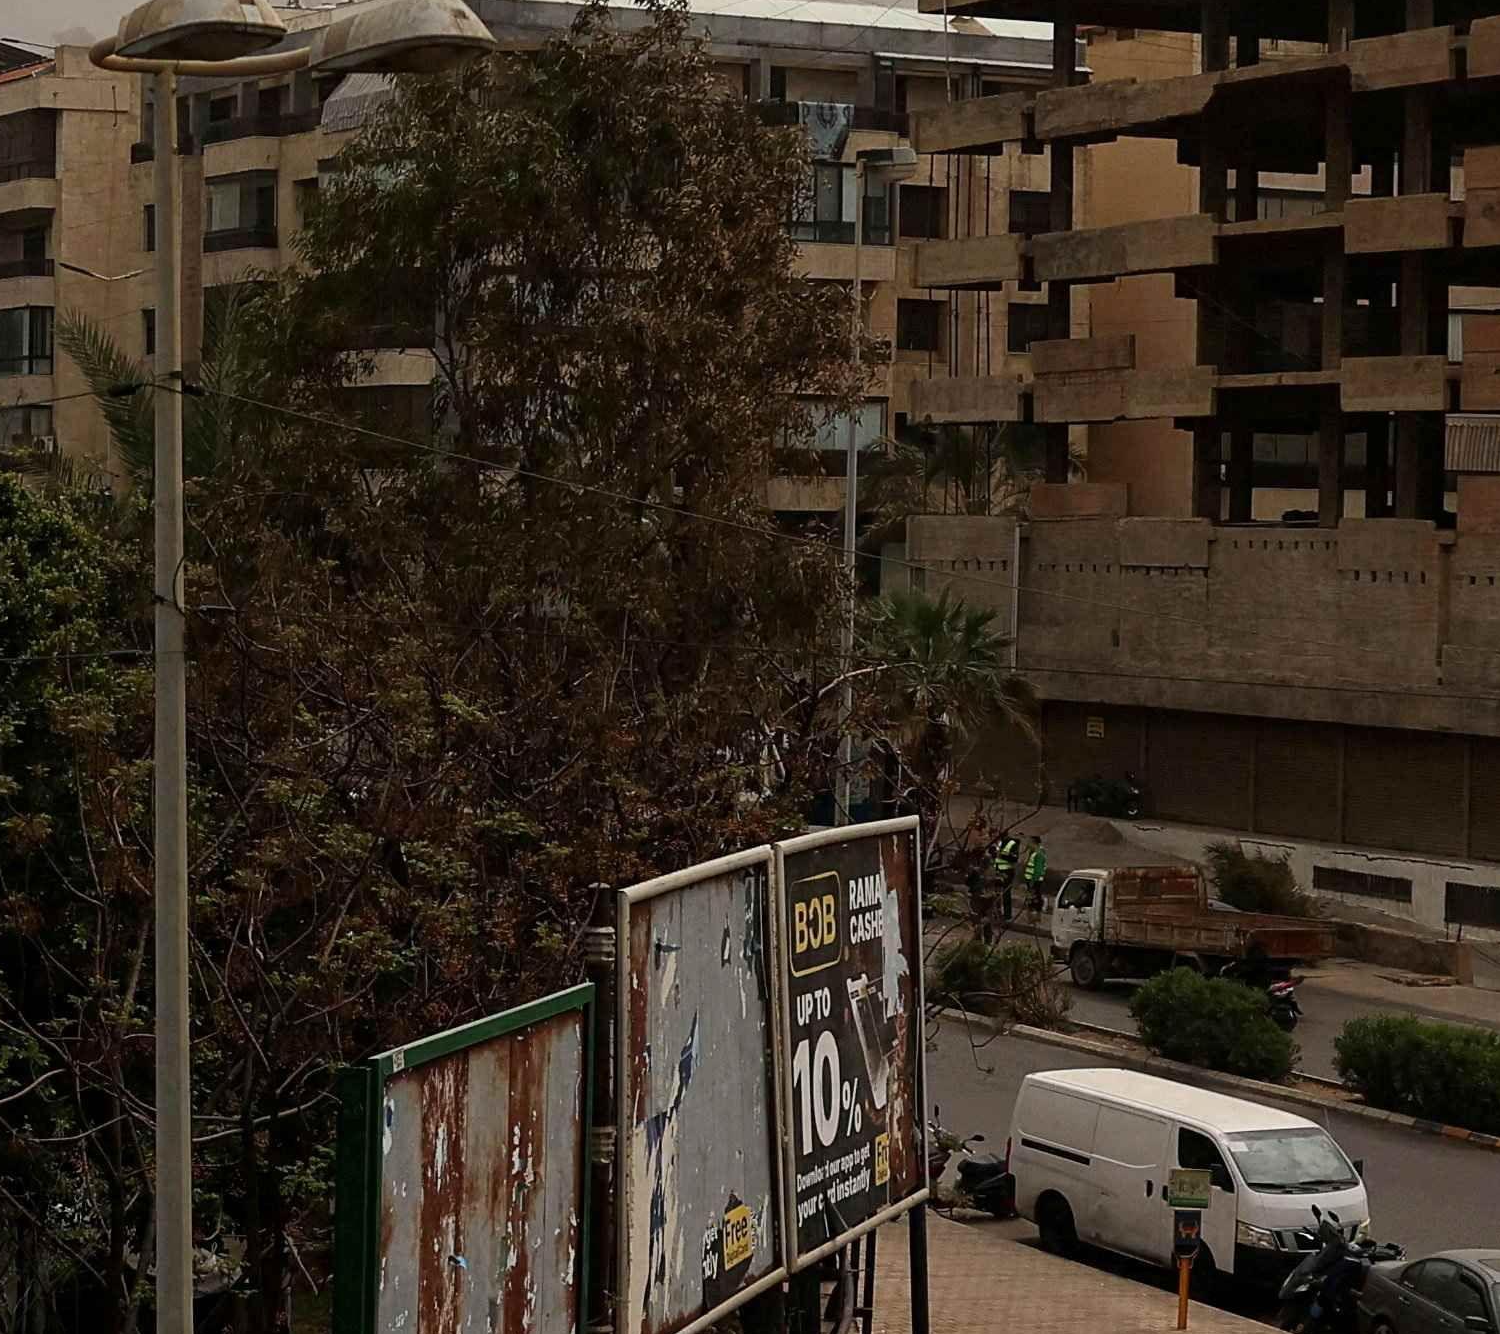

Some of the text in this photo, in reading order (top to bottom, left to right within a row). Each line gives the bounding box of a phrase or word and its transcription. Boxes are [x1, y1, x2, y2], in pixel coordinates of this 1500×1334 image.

[797, 986, 832, 1027] UP TO
[798, 1167, 871, 1228] your crd instantly
[725, 1216, 748, 1251] Free
